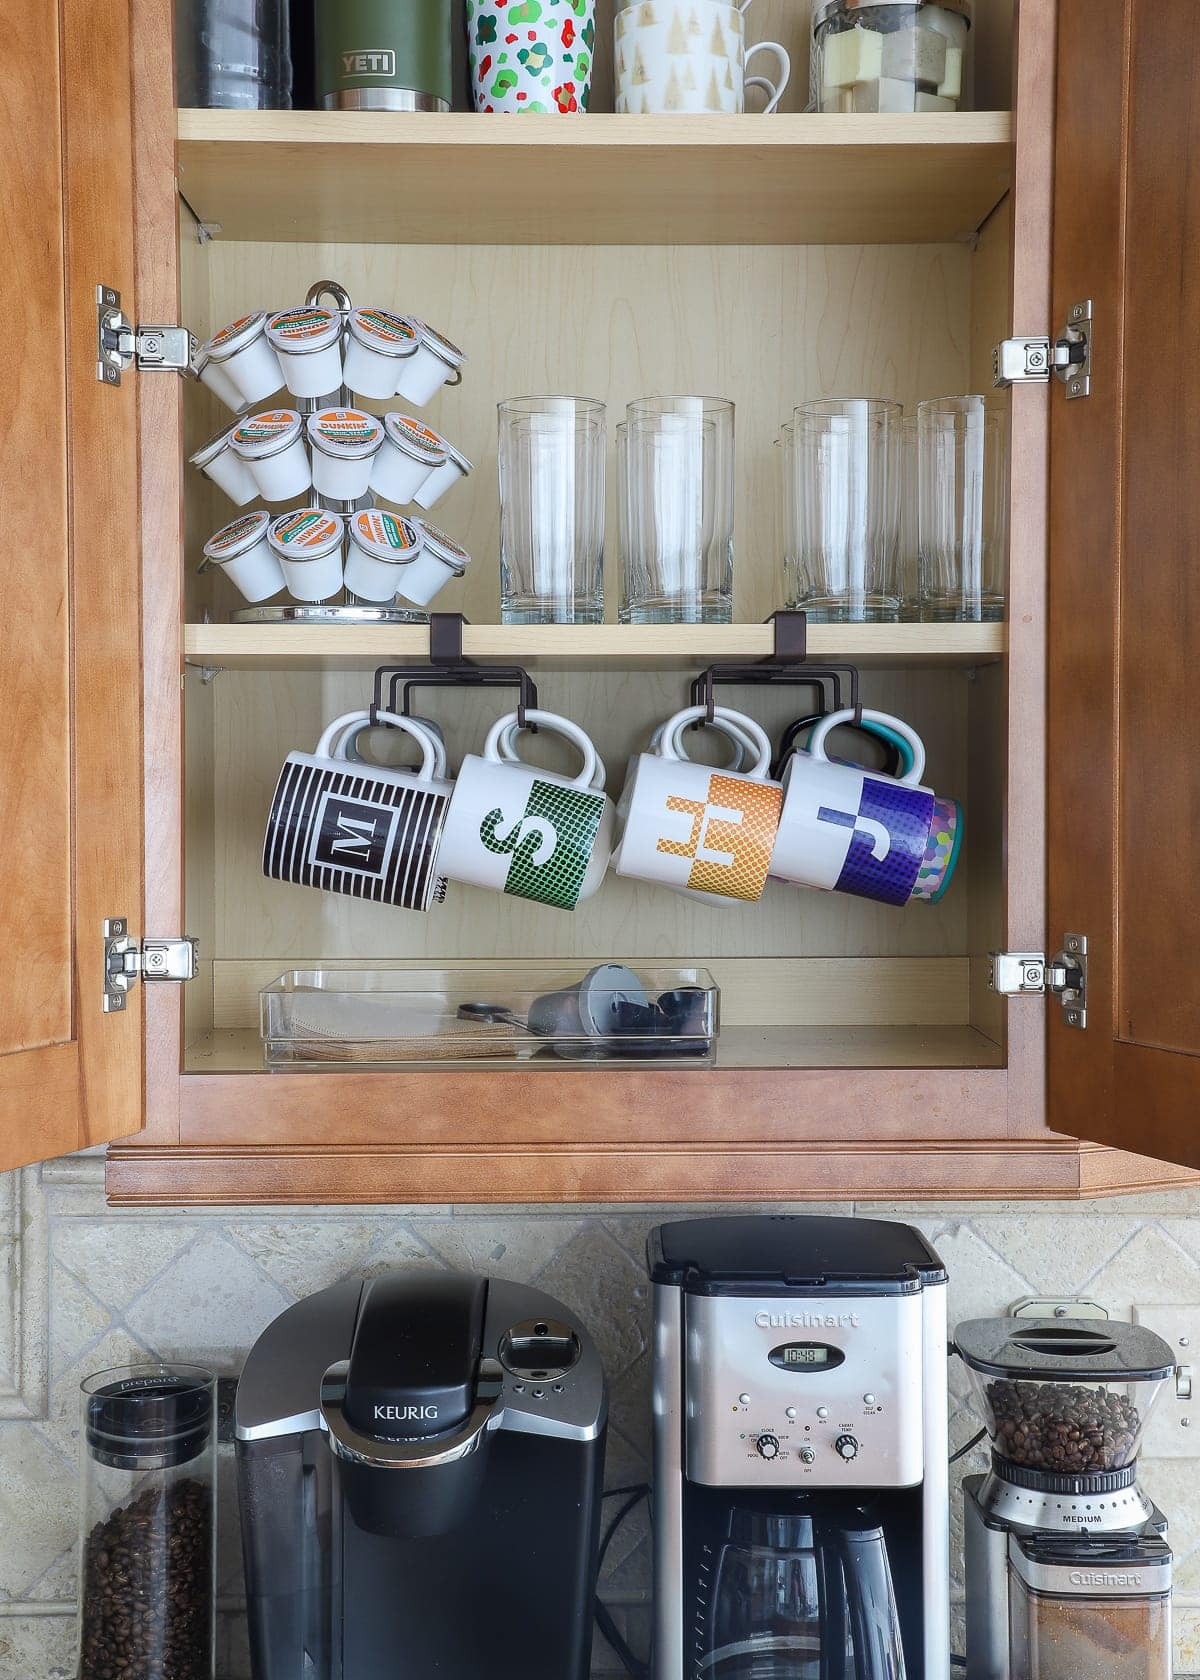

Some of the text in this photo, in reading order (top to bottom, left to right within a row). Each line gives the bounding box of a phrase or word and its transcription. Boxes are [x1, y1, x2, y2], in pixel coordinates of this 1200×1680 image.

[341, 54, 389, 72] YETI
[330, 810, 378, 863] M
[480, 807, 557, 866] S
[817, 806, 891, 862] J
[754, 1311, 862, 1329] Cuisinart
[120, 1376, 180, 1390] prepara
[374, 1405, 438, 1420] KEURIG
[1062, 1515, 1102, 1523] MEDIUM
[1069, 1571, 1142, 1586] Cuisinart
